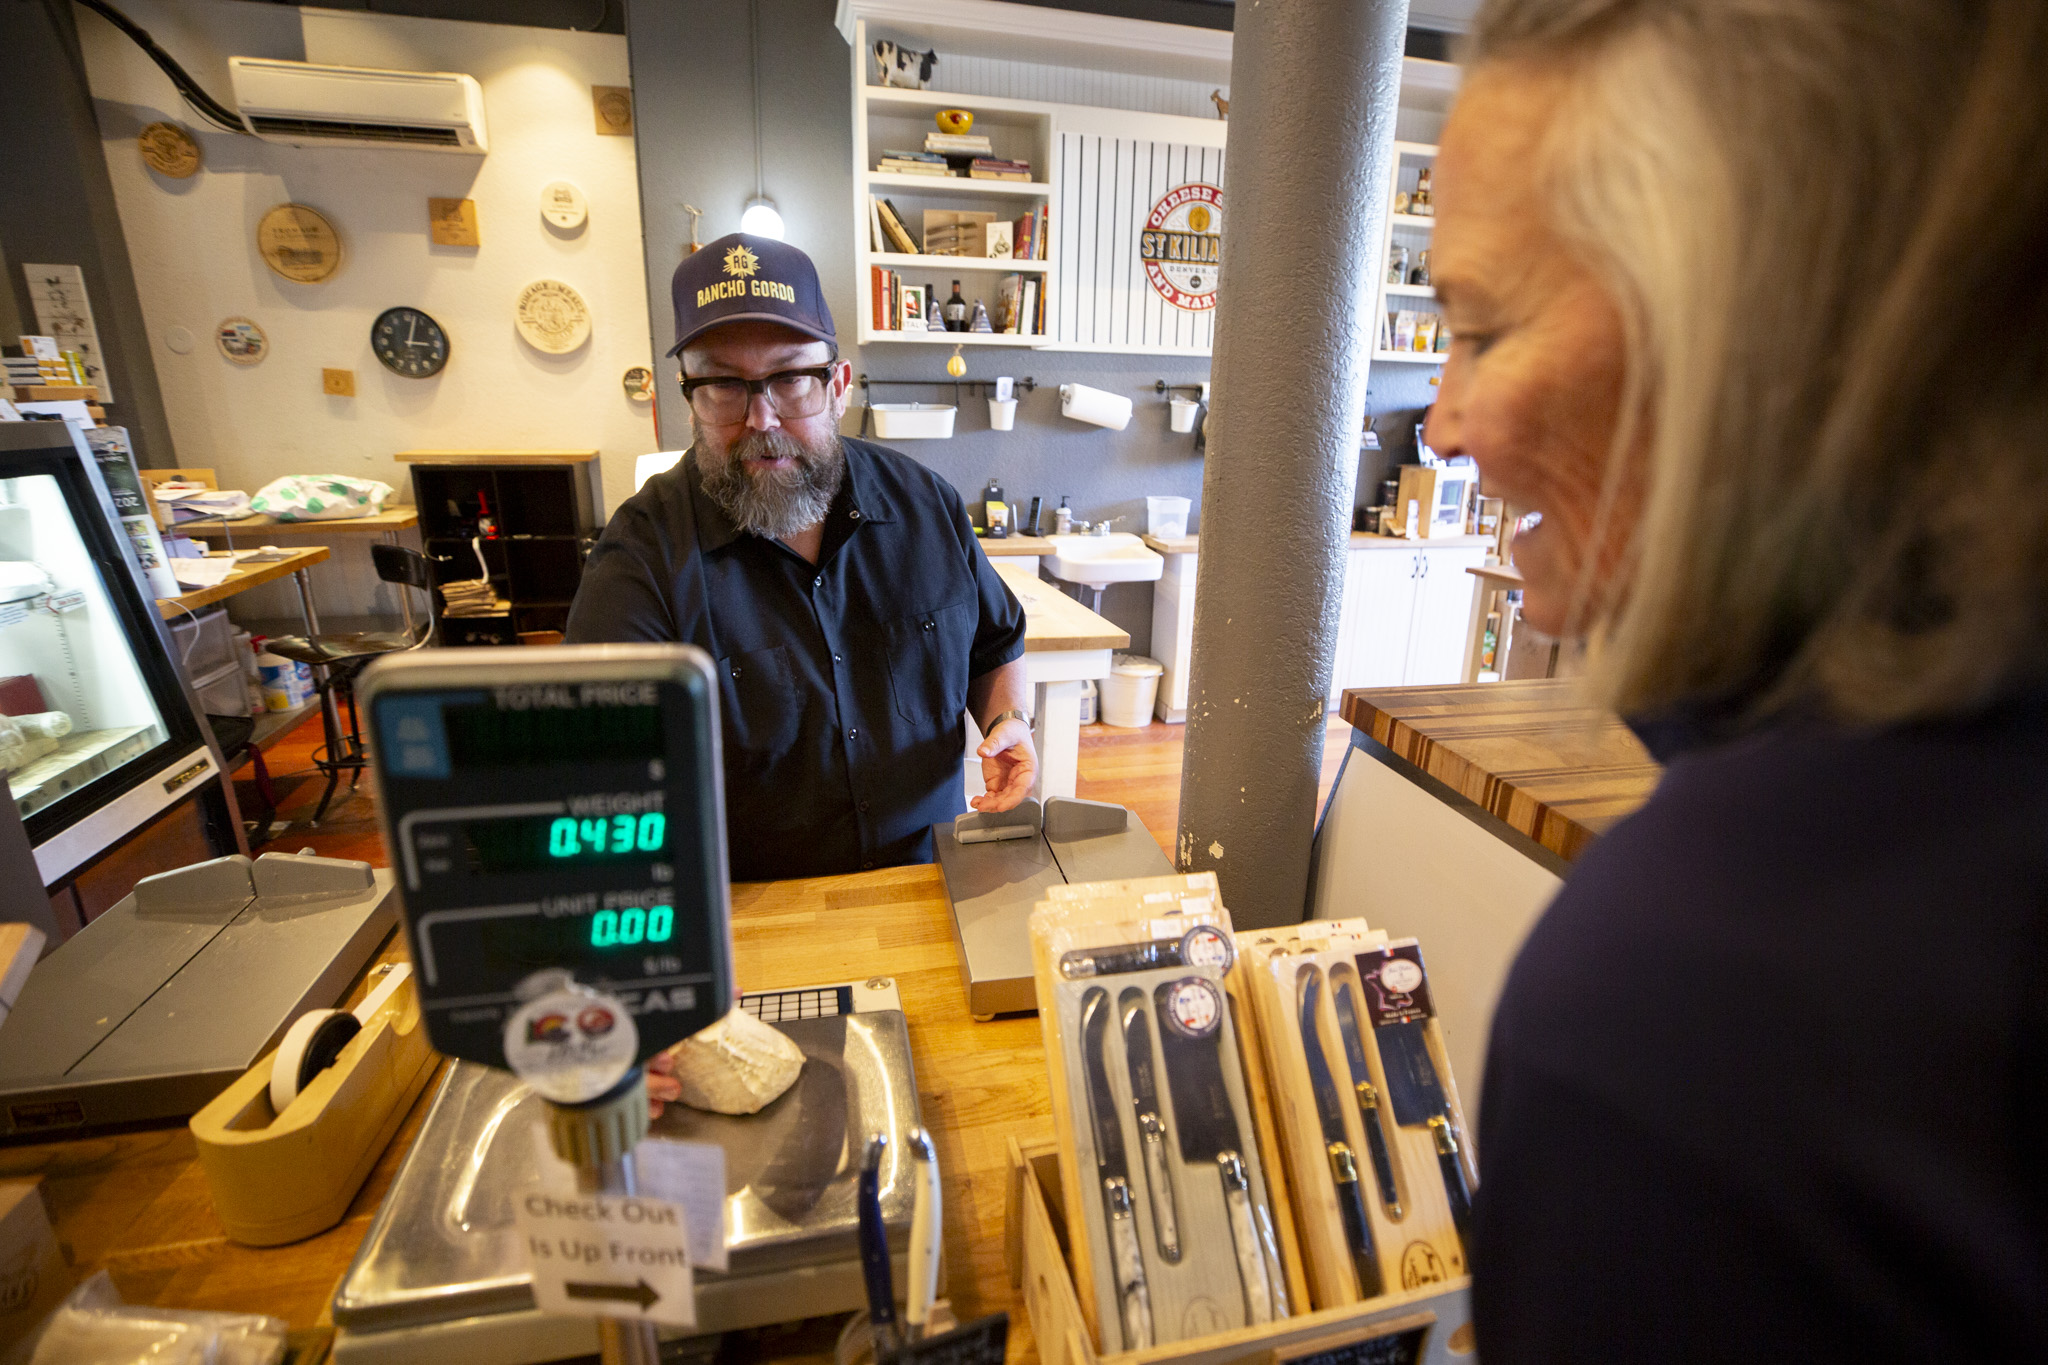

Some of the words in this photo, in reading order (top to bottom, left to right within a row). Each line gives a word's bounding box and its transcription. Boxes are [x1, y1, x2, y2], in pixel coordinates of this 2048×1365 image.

[1151, 186, 1213, 227] CHEESE
[733, 255, 749, 269] RG
[697, 279, 746, 308] RANCHO
[750, 279, 796, 304] GORDO
[1147, 264, 1174, 298] AND
[1176, 289, 1219, 309] MAR
[494, 688, 576, 711] TOTAL
[582, 683, 660, 707] PRICE
[568, 791, 665, 816] WEIGHT
[548, 812, 667, 858] 0.430
[541, 894, 596, 919] UNIT
[601, 887, 675, 912] PRICE
[590, 904, 675, 948] 0.00
[525, 1194, 611, 1220] Check
[622, 1199, 678, 1224] Out
[529, 1236, 553, 1258] Is
[559, 1239, 602, 1264] Up
[609, 1242, 686, 1268] Front
